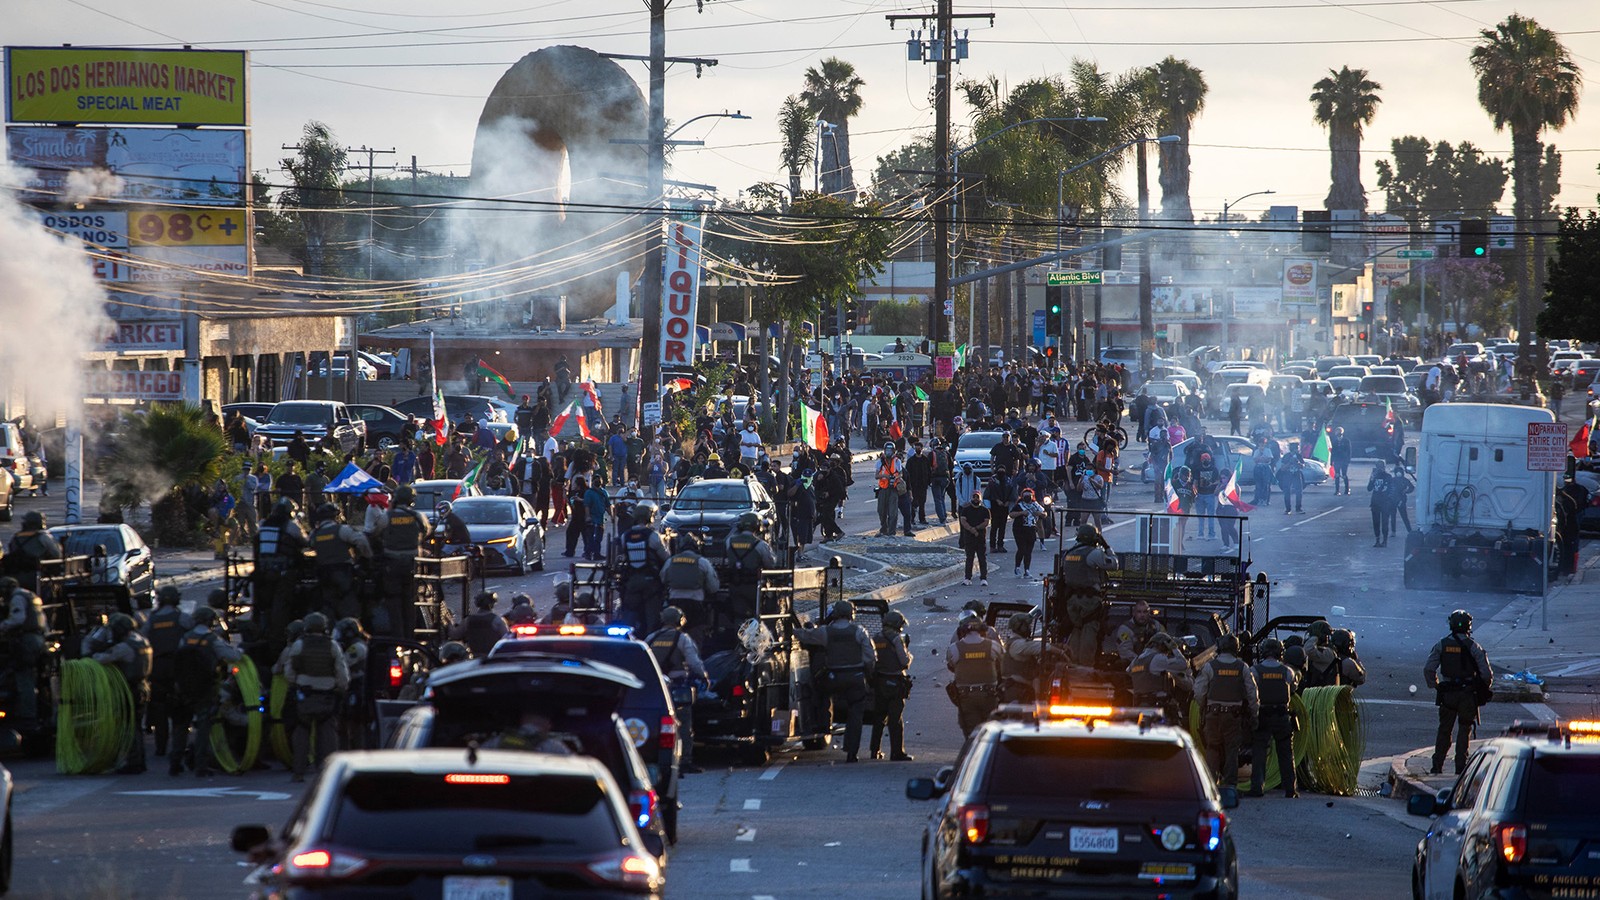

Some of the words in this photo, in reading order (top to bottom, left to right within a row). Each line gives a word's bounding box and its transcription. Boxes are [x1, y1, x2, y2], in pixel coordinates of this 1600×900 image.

[17, 70, 45, 101] LOS
[51, 64, 80, 93] DOS
[86, 61, 169, 90] HERMANOS
[174, 65, 236, 103] MARKET
[77, 96, 139, 110] SPECIAL
[143, 96, 182, 111] MEAT
[22, 136, 86, 158] Sinaloa
[1050, 273, 1081, 281] Atlantic
[1082, 271, 1100, 280] Blvd
[664, 223, 693, 362] LIQUOR
[95, 324, 180, 343] ARKET
[1530, 424, 1539, 435] NO
[1540, 424, 1566, 435] PARKING
[1530, 436, 1550, 446] ENTIRE
[1552, 436, 1566, 446] CITY
[994, 856, 1008, 864] LOS
[1012, 856, 1047, 865] ANGELES
[1050, 857, 1080, 866] COUNTY
[1010, 867, 1063, 878] SHERIFF
[1552, 875, 1589, 885] ANGELES
[1551, 887, 1599, 899] SHERIF
